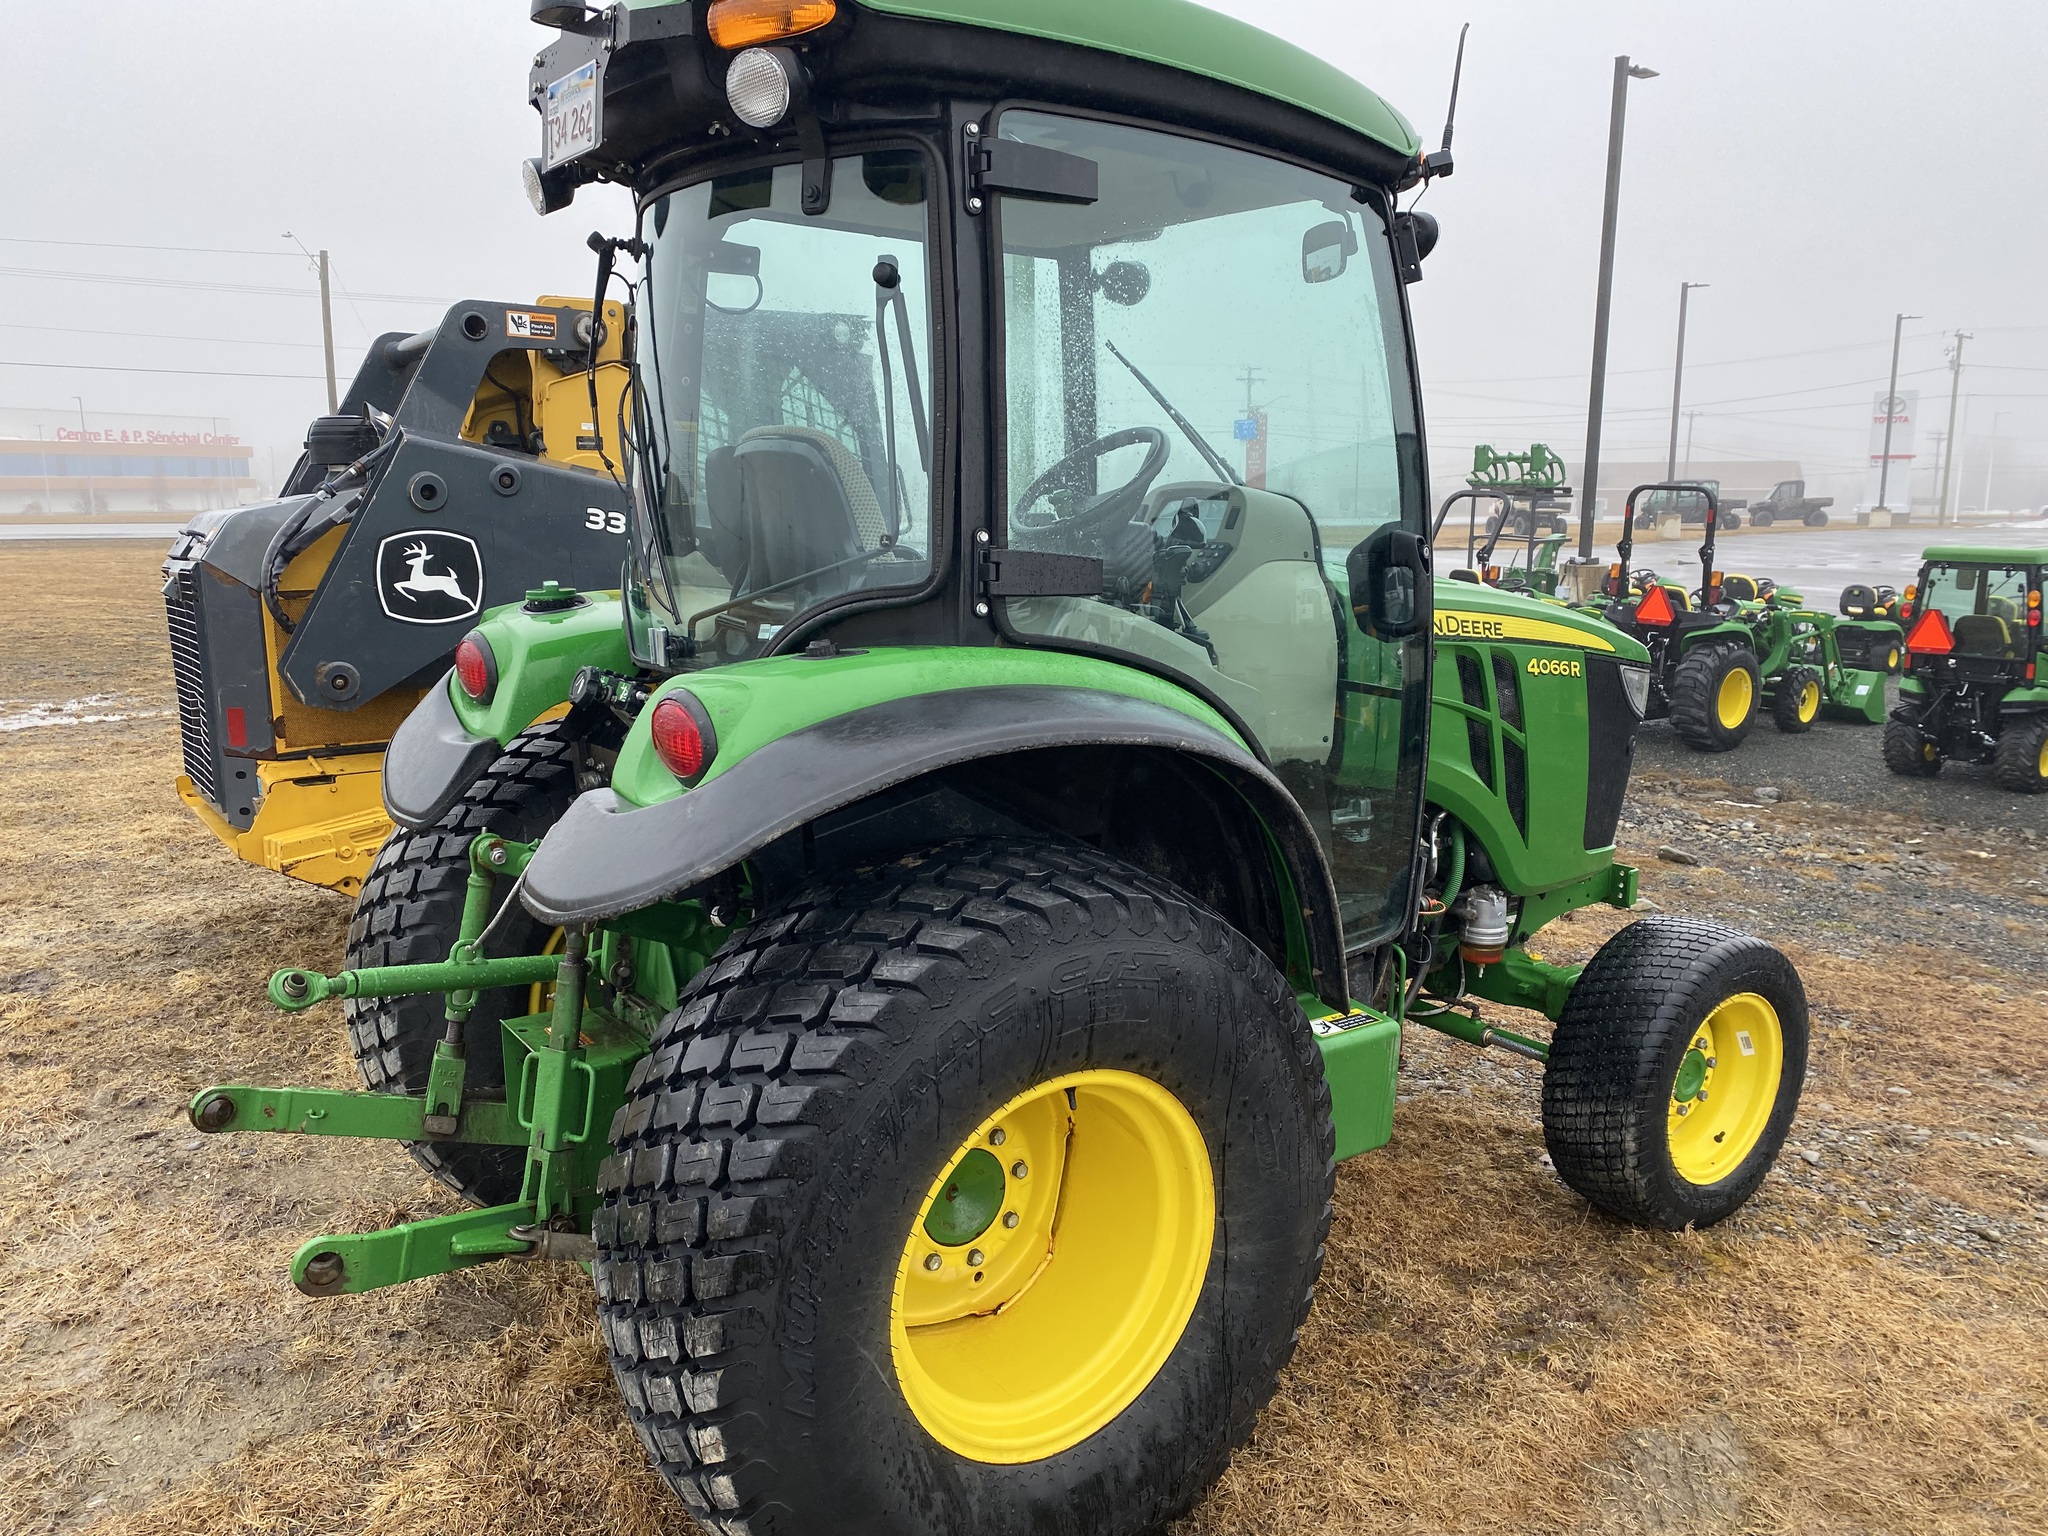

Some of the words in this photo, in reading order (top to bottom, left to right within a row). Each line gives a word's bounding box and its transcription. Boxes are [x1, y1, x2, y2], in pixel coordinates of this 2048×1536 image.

[548, 112, 567, 152] T34
[571, 100, 592, 139] 262
[57, 427, 102, 441] Centre
[104, 430, 117, 442] E.
[120, 431, 130, 443] &
[133, 431, 145, 443] P.
[147, 430, 200, 444] Sénéchal
[203, 433, 240, 446] Center
[585, 507, 626, 534] 33
[1446, 615, 1503, 636] DEERE
[1526, 658, 1581, 678] 4066R
